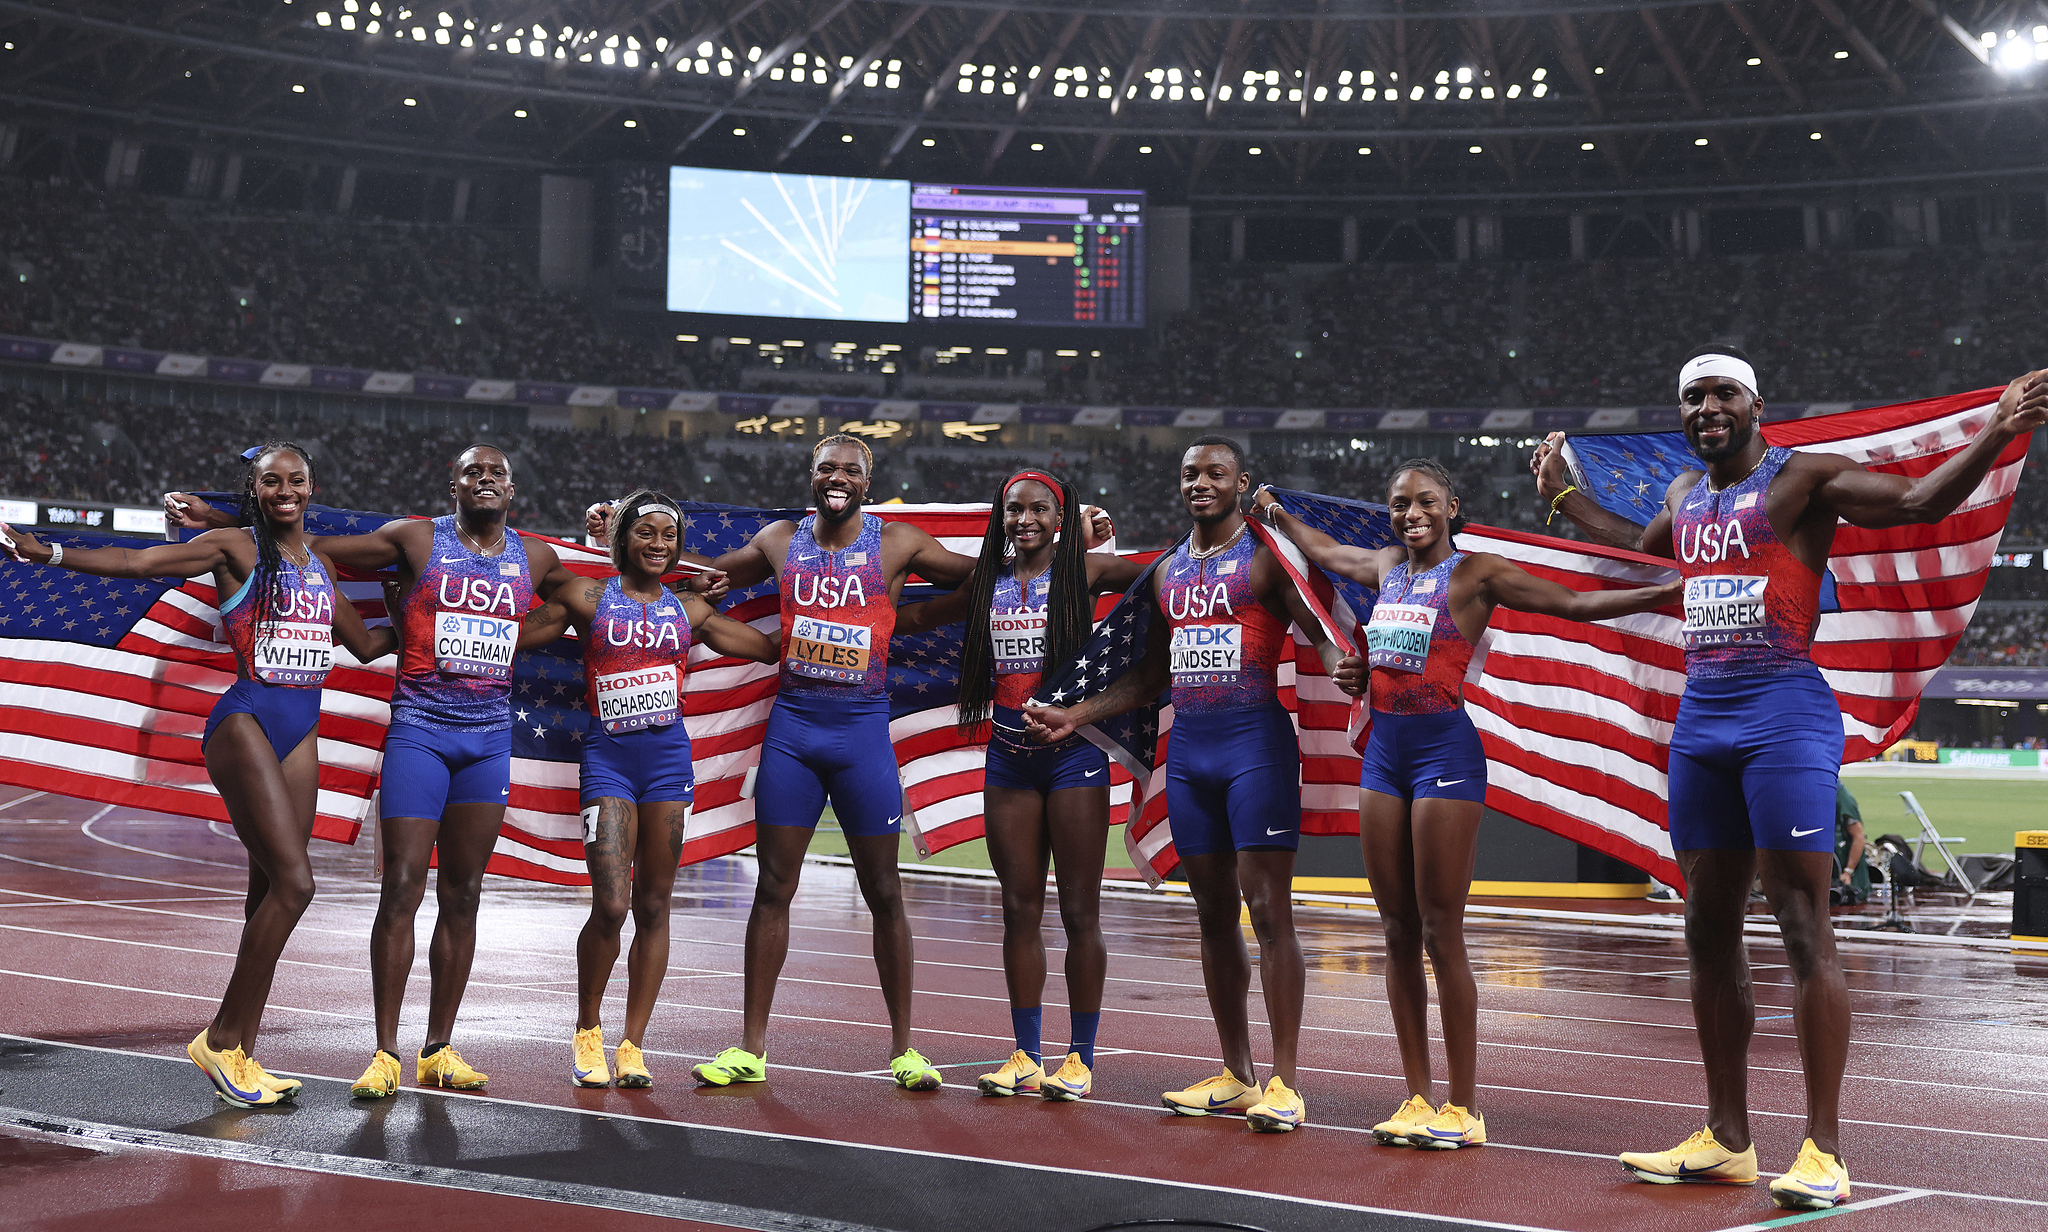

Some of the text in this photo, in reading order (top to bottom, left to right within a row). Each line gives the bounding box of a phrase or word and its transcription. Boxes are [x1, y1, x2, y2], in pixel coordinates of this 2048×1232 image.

[1680, 519, 1750, 564] USA
[439, 573, 516, 616] USA
[794, 573, 866, 609] USA
[1169, 582, 1233, 620] USA
[1700, 579, 1760, 599] TDK
[273, 584, 333, 621] USA
[991, 618, 1047, 631] HOND
[1687, 603, 1761, 628] BEDNAREK
[259, 627, 331, 643] HONDA
[460, 617, 513, 641] TDK
[607, 618, 680, 650] USA
[812, 621, 865, 646] TDK
[1183, 627, 1234, 646] TDK
[262, 646, 331, 667] WHITE
[439, 637, 511, 664] COLEMAN
[797, 640, 860, 667] LYLES
[995, 636, 1045, 657] TERR
[1172, 649, 1236, 669] LINDSEY
[598, 670, 675, 692] HONDA
[601, 688, 676, 718] RICHARDSON
[1949, 749, 2011, 766] Salonpas
[2026, 835, 2048, 846] SE
